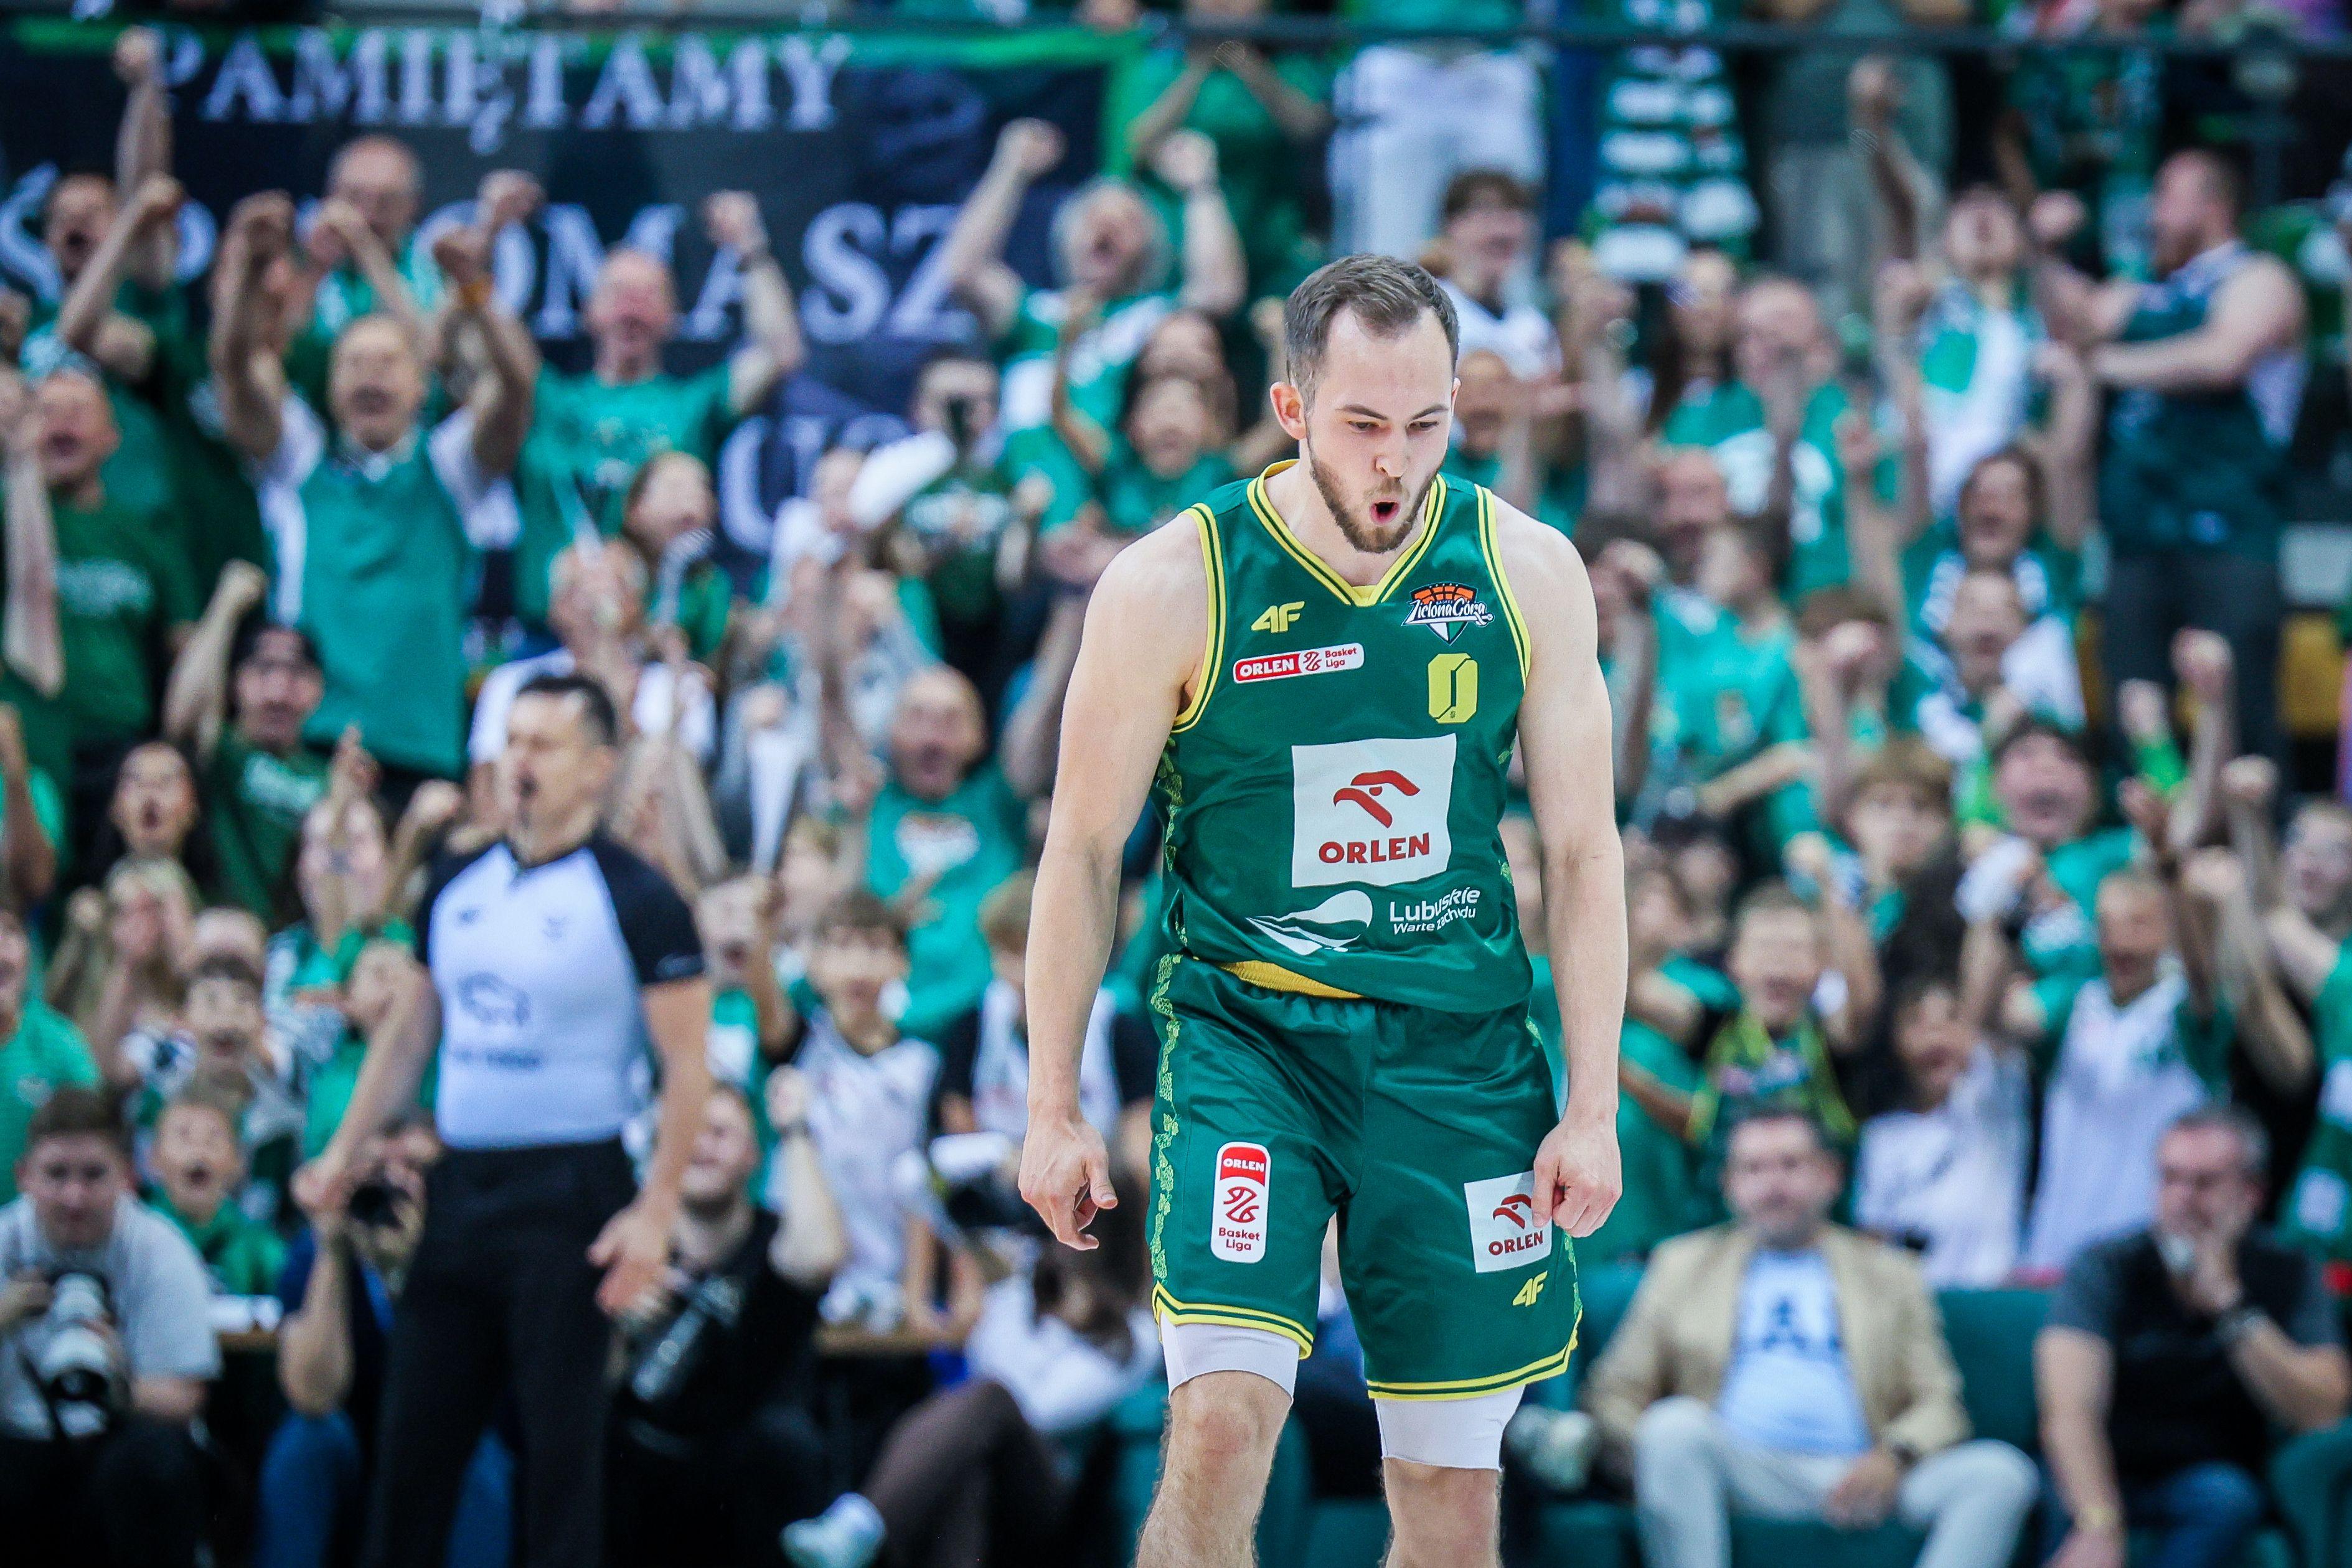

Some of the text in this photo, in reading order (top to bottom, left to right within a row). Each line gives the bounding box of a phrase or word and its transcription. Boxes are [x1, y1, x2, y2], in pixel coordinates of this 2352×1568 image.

[156, 29, 853, 154] PAMIĘTAMY
[294, 200, 981, 344] OMASZ
[1251, 601, 1305, 633] 4F
[1325, 647, 1357, 658] Basket
[1325, 659, 1345, 669] Liga
[1240, 659, 1294, 677] ORLEN
[1428, 653, 1479, 723] 0
[1319, 832, 1430, 864] ORLEN
[1390, 886, 1480, 922] Lubuskie
[1393, 922, 1435, 935] Warte
[1223, 1158, 1264, 1172] ORLEN
[1218, 1227, 1260, 1241] Basket
[1226, 1238, 1252, 1252] Liga
[1489, 1230, 1543, 1256] ORLEN
[1512, 1270, 1548, 1307] 4F
